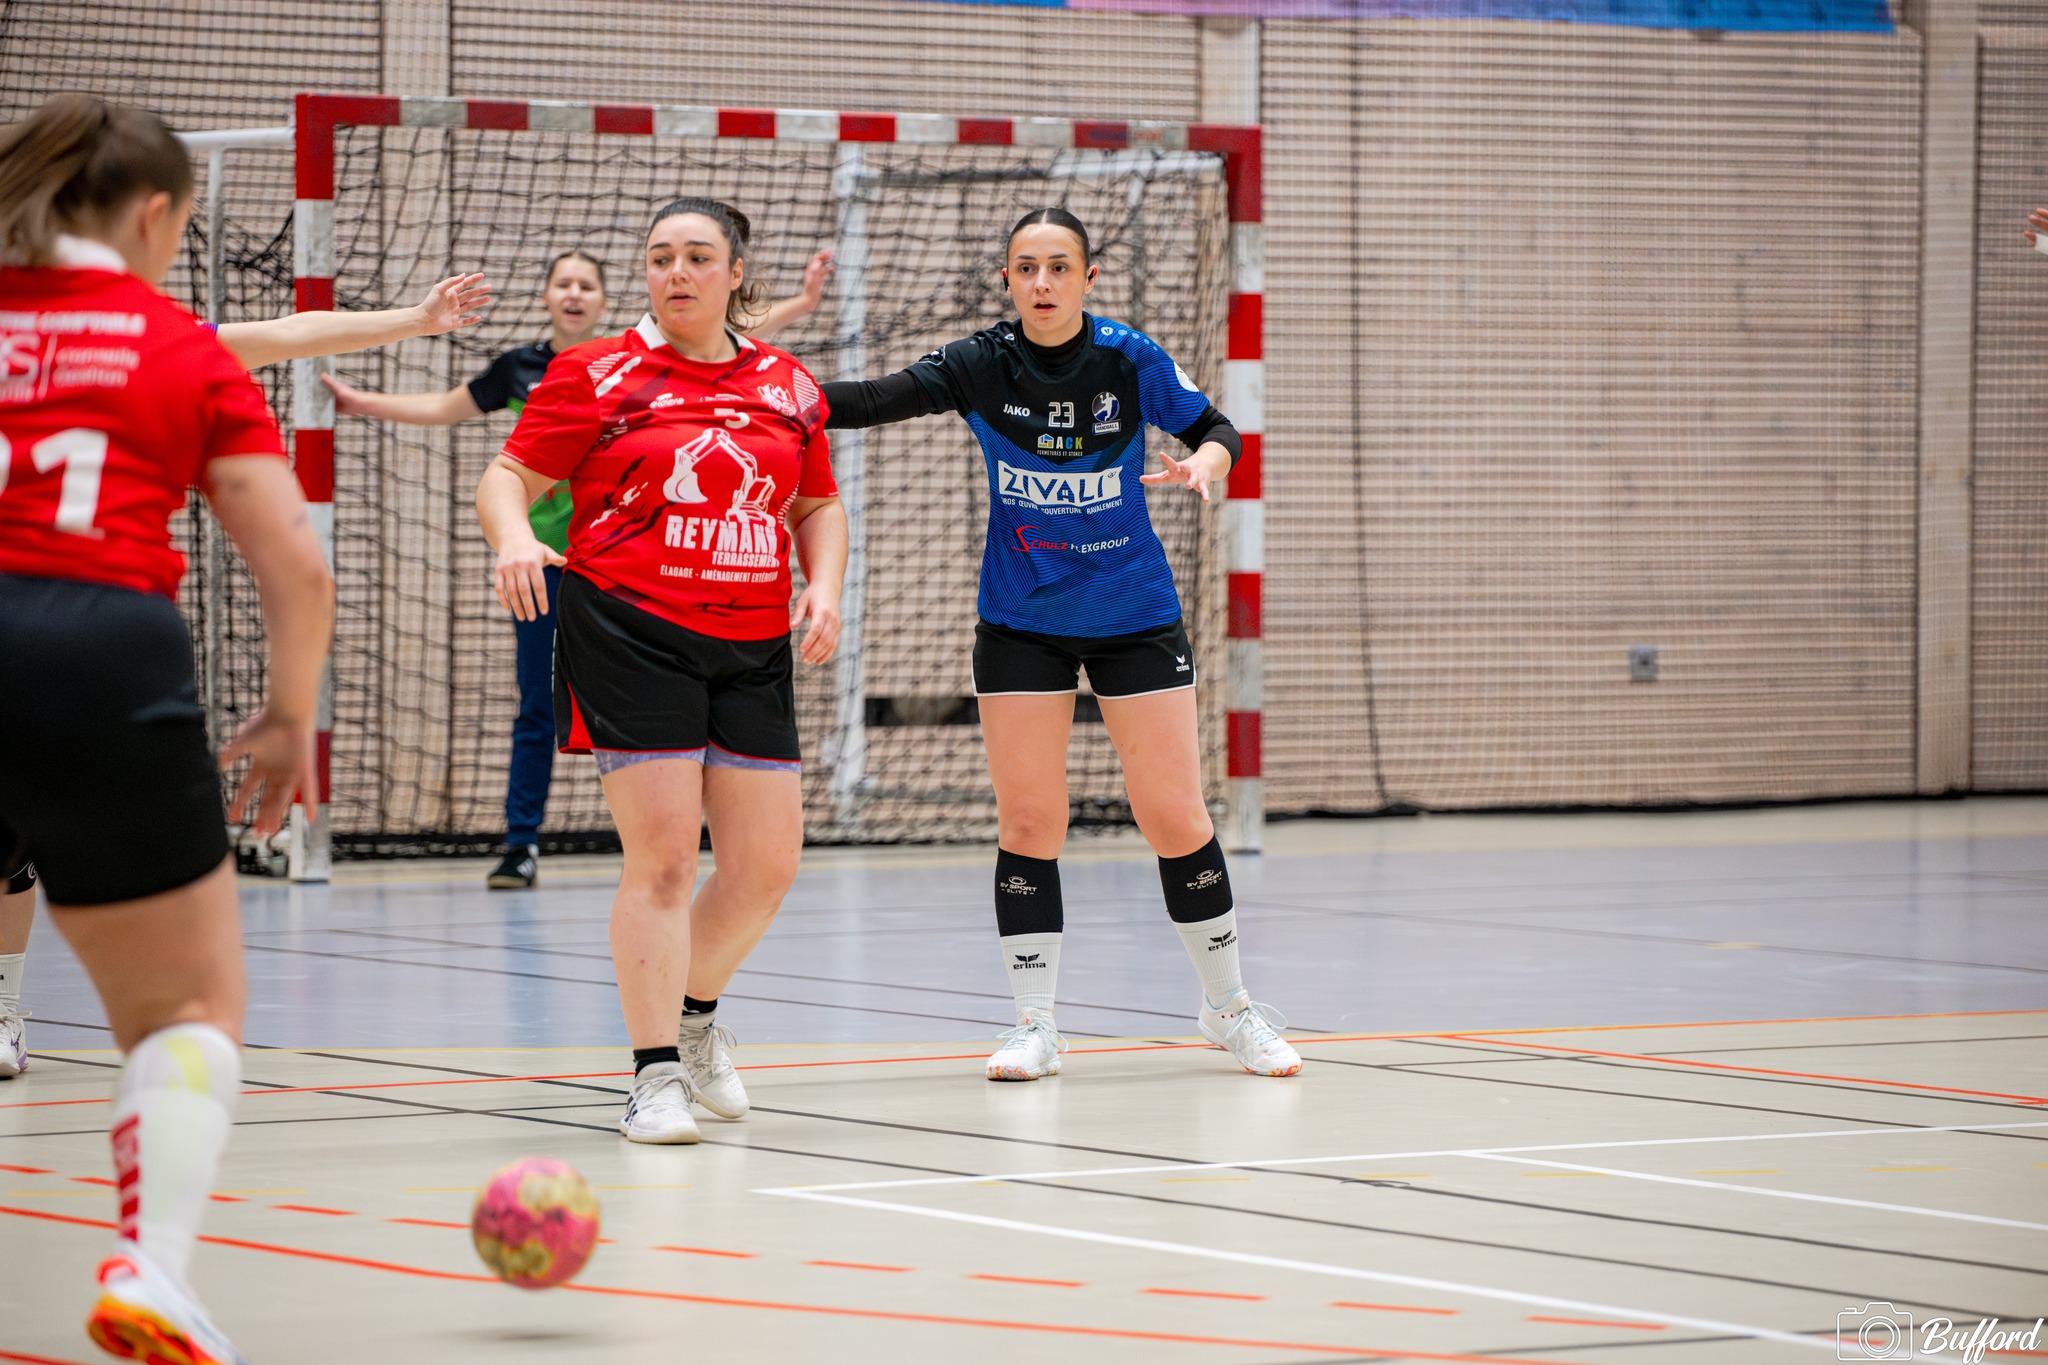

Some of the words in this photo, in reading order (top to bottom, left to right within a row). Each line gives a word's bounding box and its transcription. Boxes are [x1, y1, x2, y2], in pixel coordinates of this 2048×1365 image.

[1003, 403, 1030, 417] JAKO
[1048, 401, 1074, 428] 23
[1056, 436, 1083, 449] ACK
[0, 427, 109, 540] 1
[1003, 467, 1104, 503] ZIVALI
[1087, 499, 1123, 515] RAVALEMENT
[1011, 525, 1069, 553] SCHULZ
[1199, 870, 1222, 885] SPORT
[1009, 884, 1037, 892] SPORT
[1207, 935, 1237, 952] erima
[1013, 962, 1046, 970] erima
